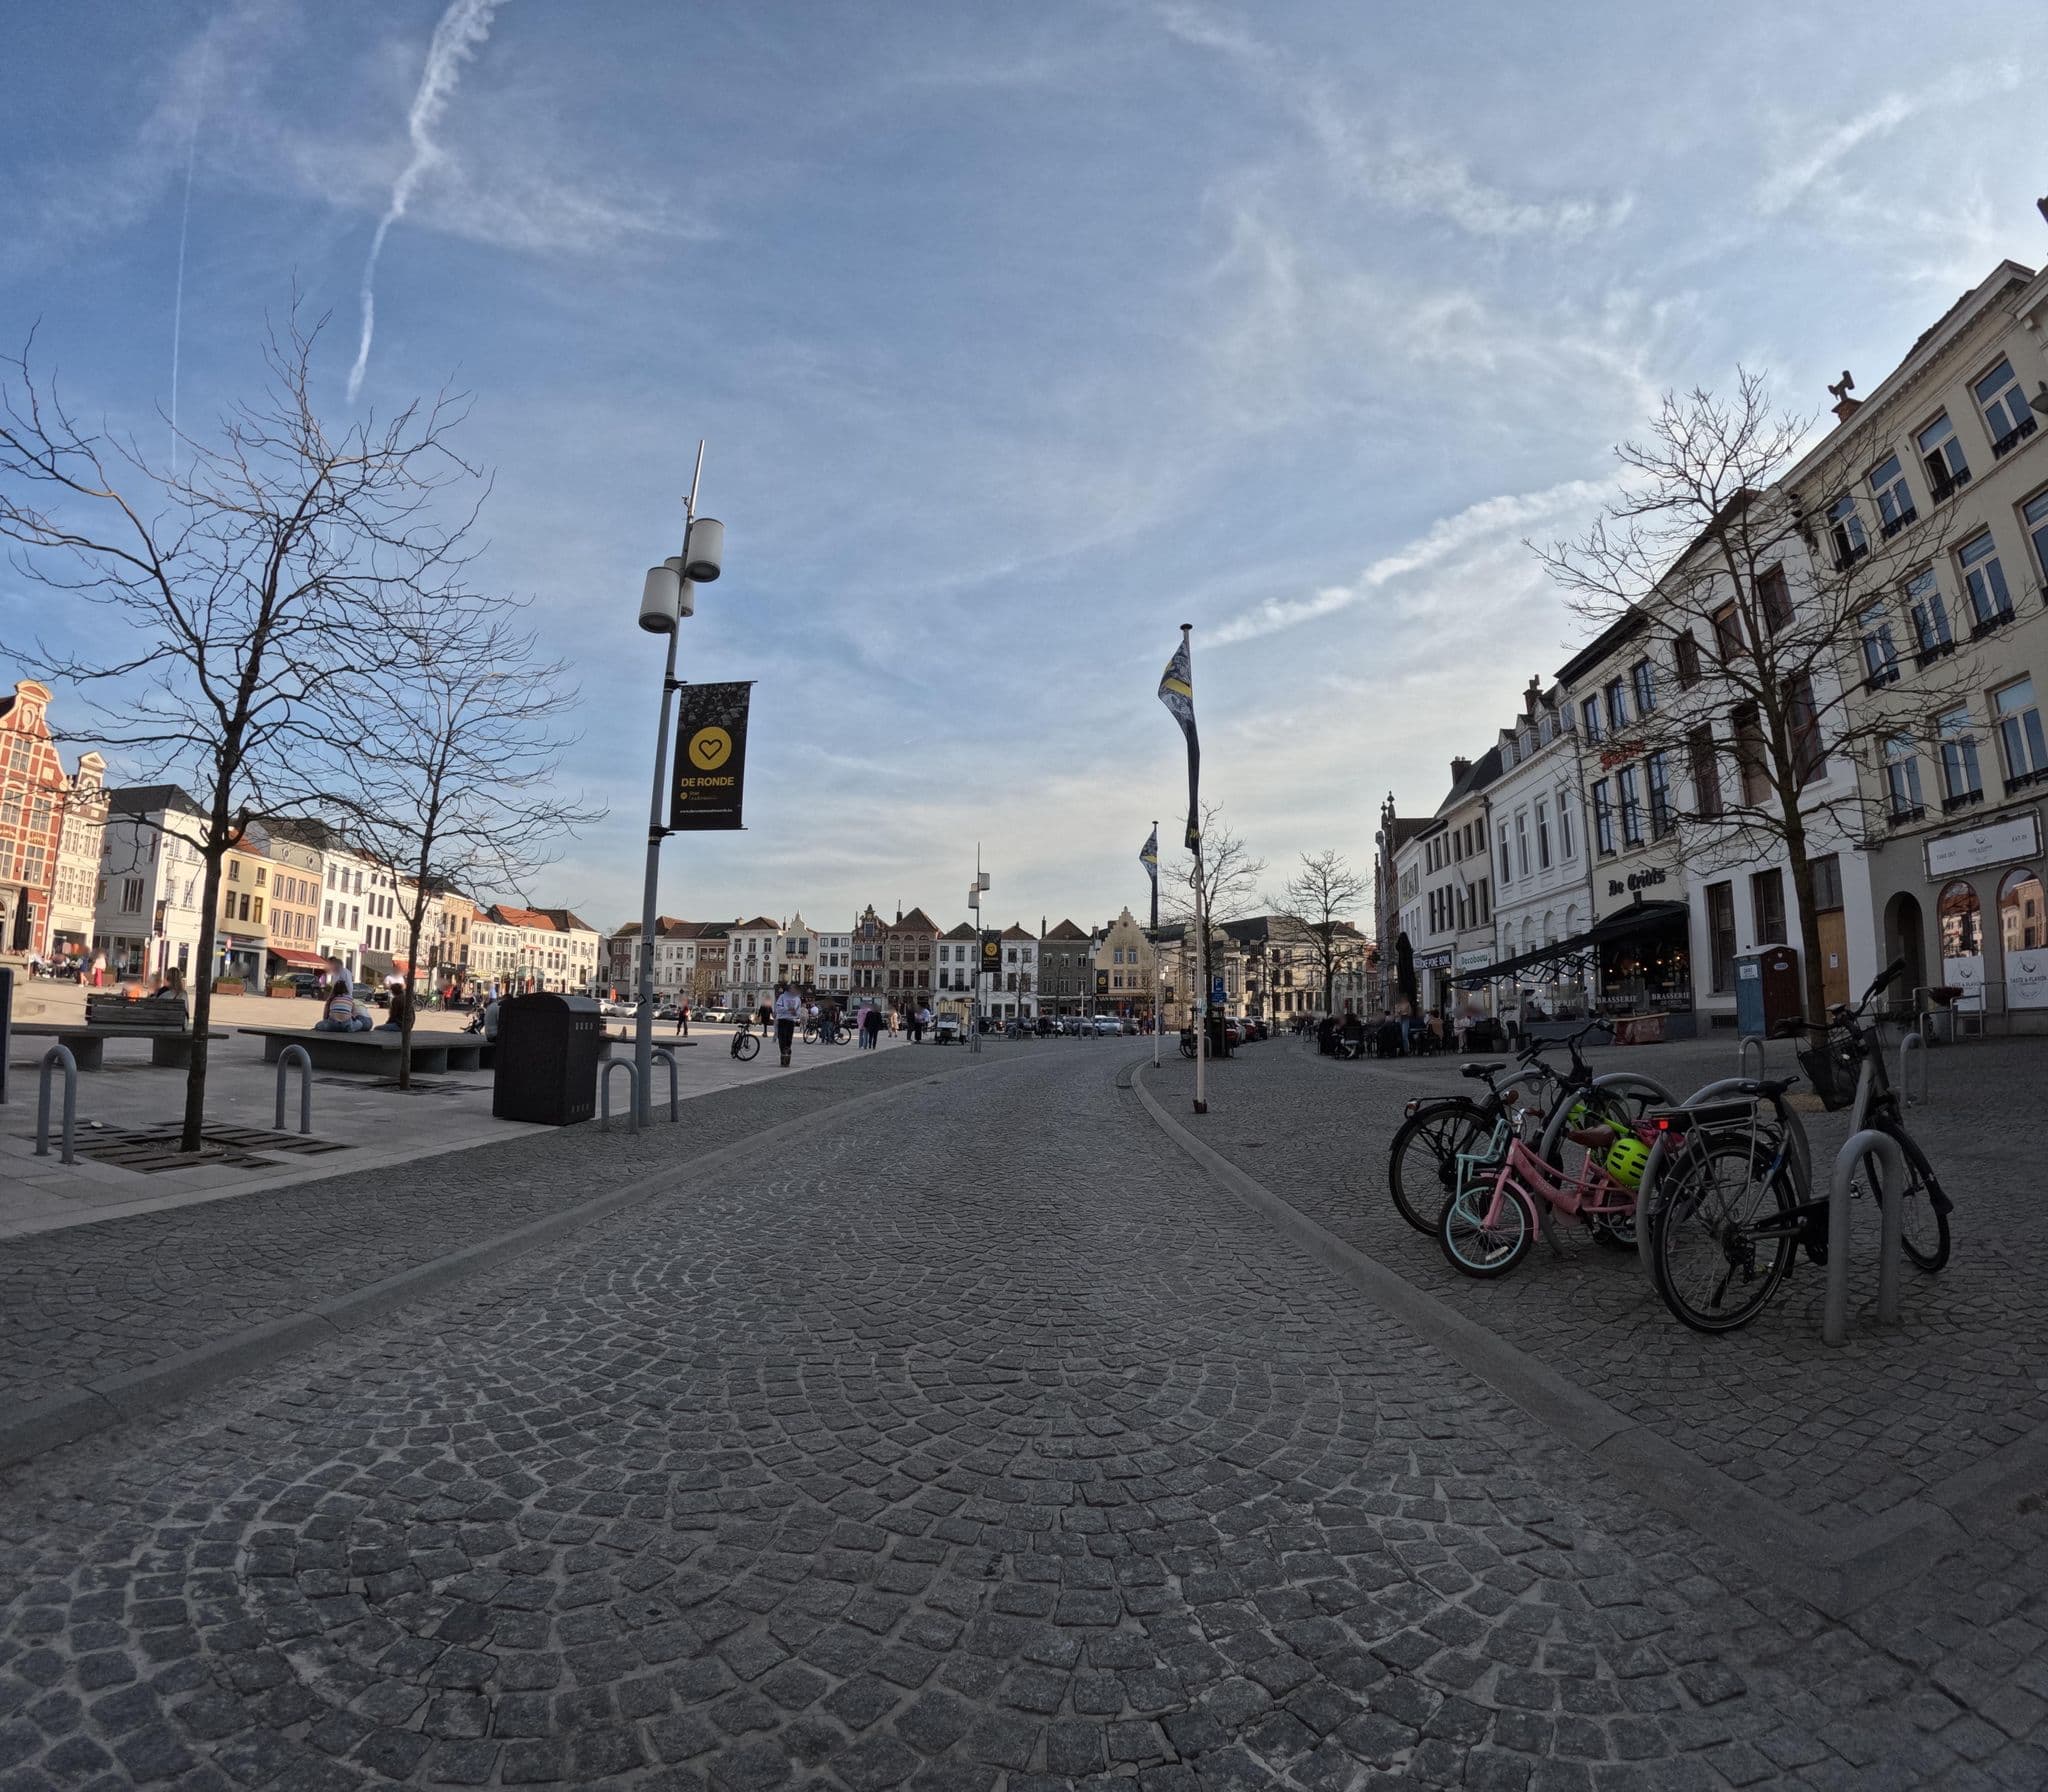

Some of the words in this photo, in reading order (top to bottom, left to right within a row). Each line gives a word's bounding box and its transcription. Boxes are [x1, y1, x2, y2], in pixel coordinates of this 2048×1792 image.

[681, 777, 696, 787] DE
[697, 776, 735, 787] RONDE
[1608, 880, 1624, 897] De
[1596, 995, 1638, 1004] BRASSERIE
[1651, 992, 1690, 1001] BRASSERIE
